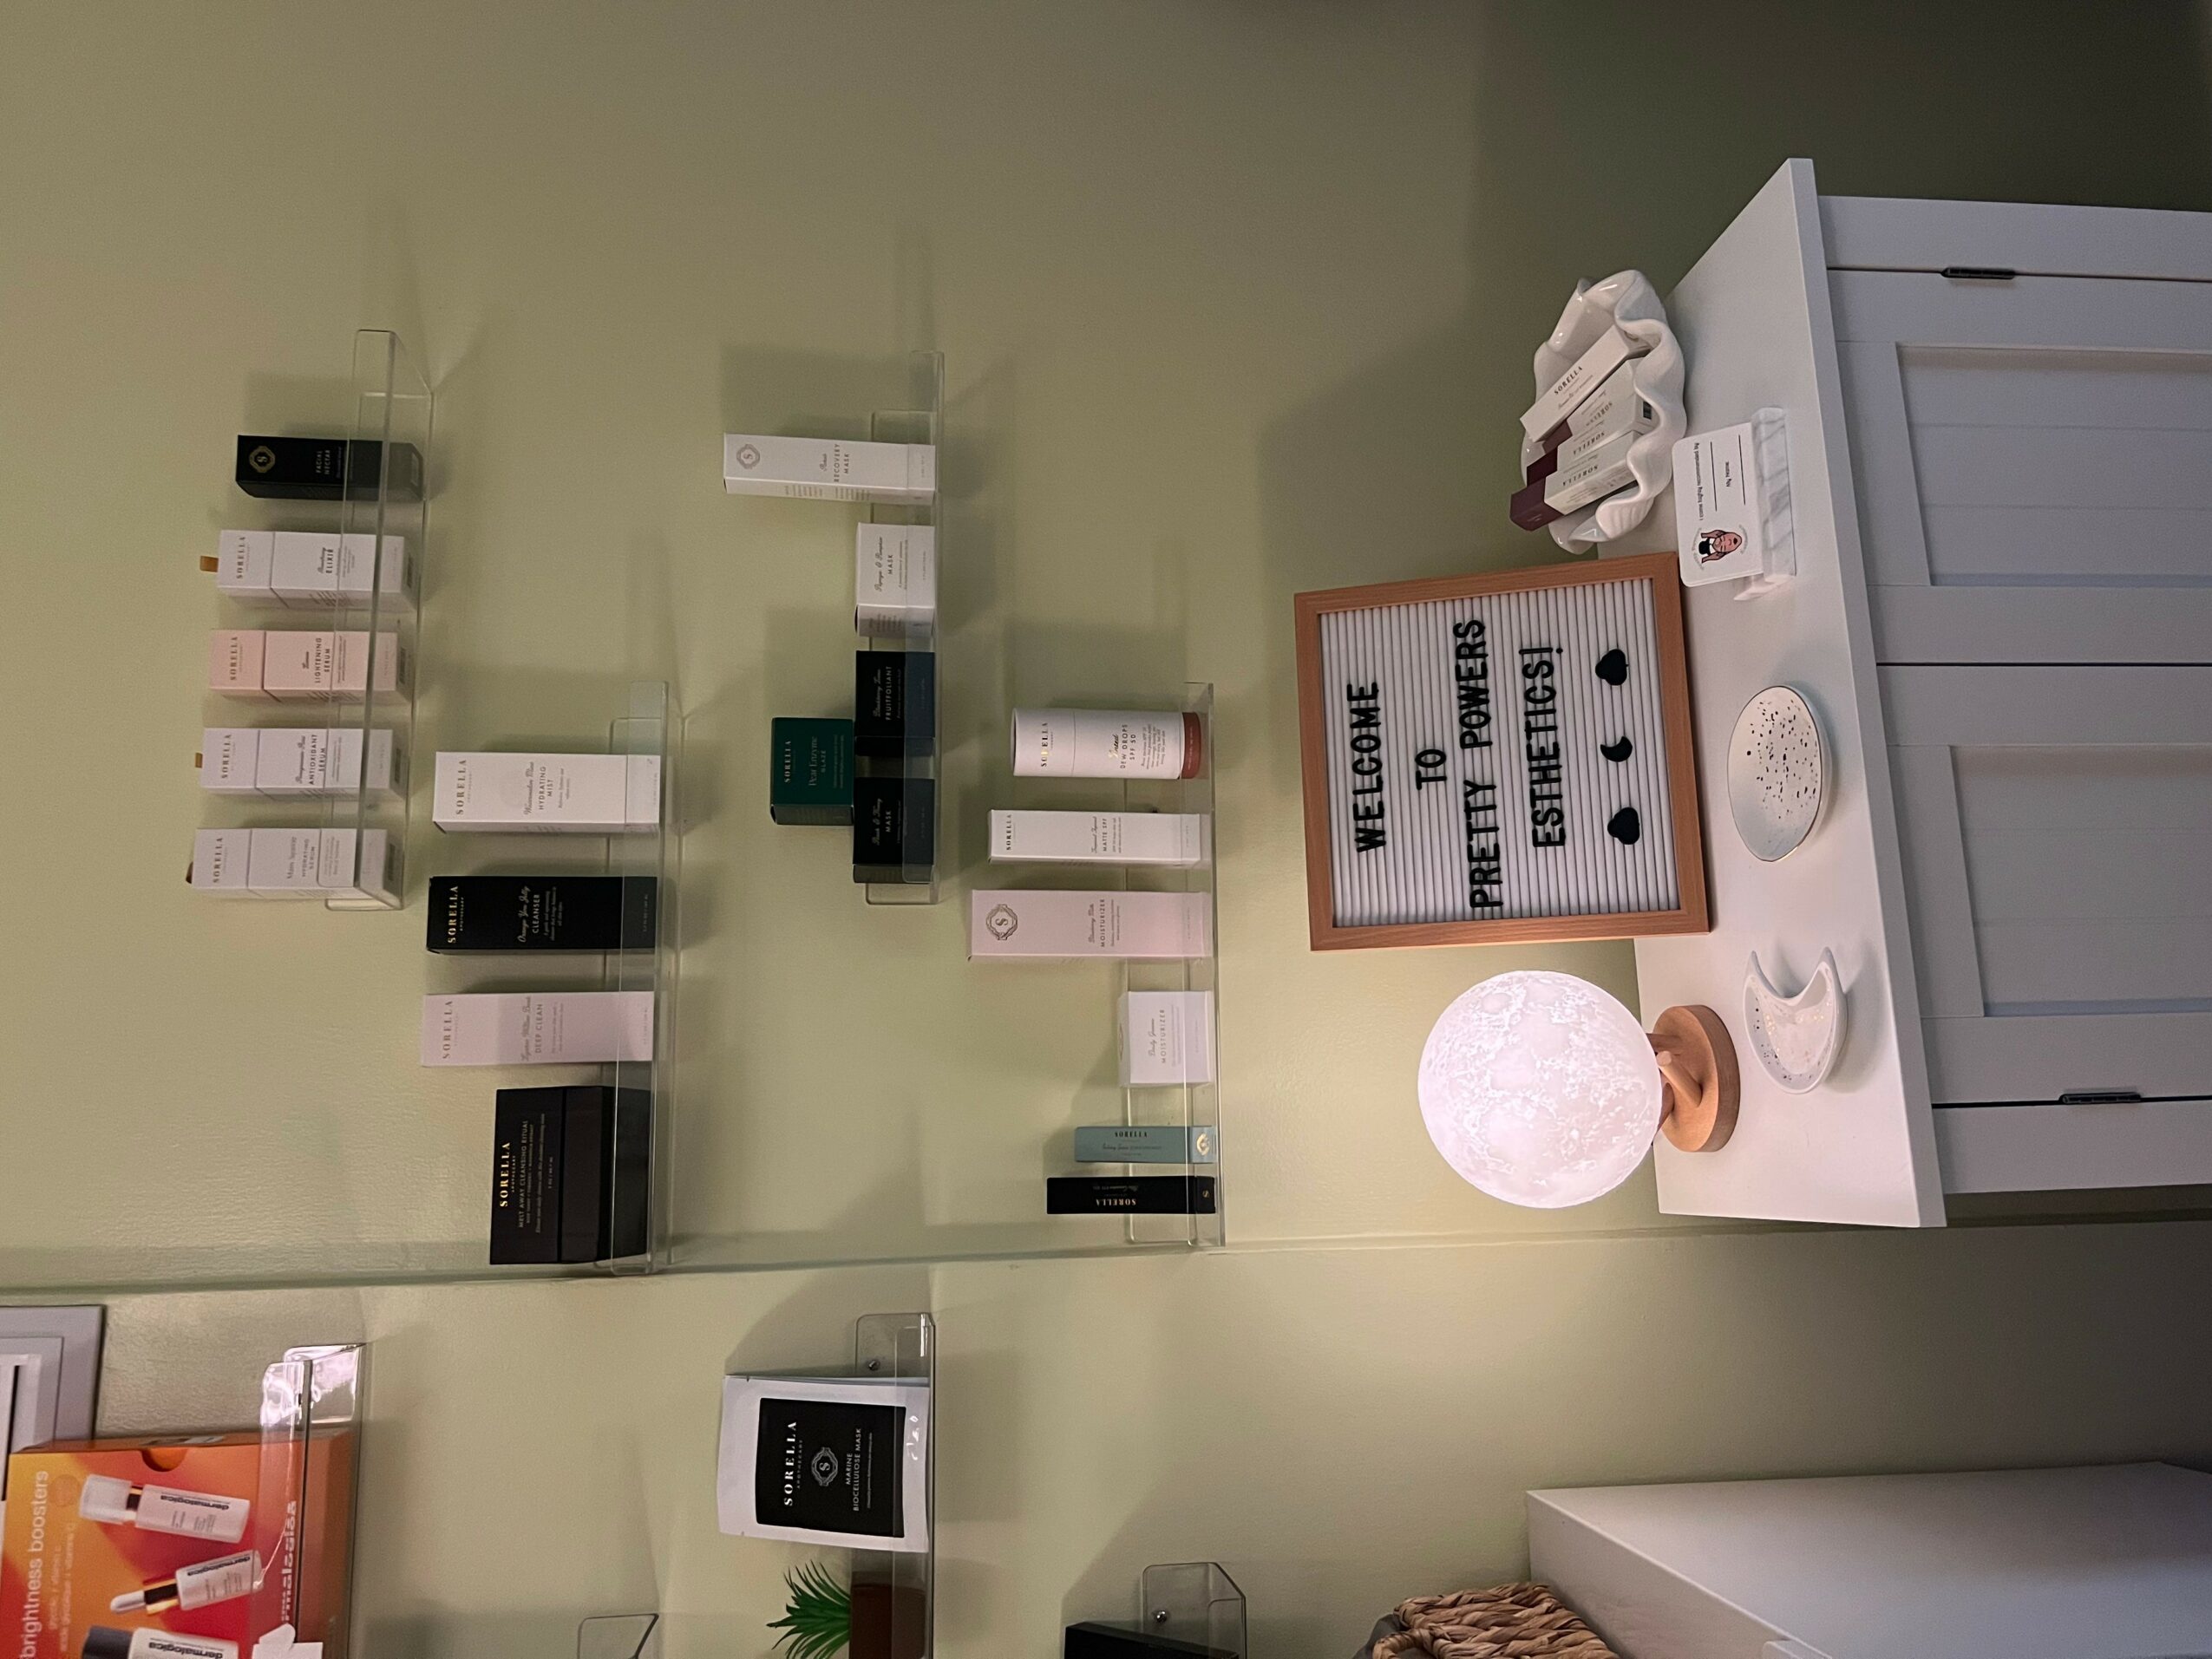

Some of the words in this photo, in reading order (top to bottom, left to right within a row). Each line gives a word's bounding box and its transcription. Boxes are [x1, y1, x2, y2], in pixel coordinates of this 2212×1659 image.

[1553, 364, 1584, 395] SORELLA
[833, 442, 841, 482] RECOVERY
[1573, 431, 1606, 456] SORELLA
[1562, 464, 1599, 486] SORELLA
[1693, 450, 1702, 486] recommended
[1725, 478, 1732, 487] My
[236, 536, 246, 579] SORELLA
[326, 548, 335, 574] ELIXIR
[229, 636, 239, 681] SORELLA
[314, 637, 323, 683] LIGHTENING
[323, 648, 331, 673] SERUM
[1452, 619, 1493, 749] POWERS
[220, 734, 232, 779] SORELLA
[808, 735, 821, 767] Enzyme
[1130, 734, 1136, 744] 50
[1518, 647, 1567, 848] ESTHETICS!
[309, 734, 318, 786] ANTIOXIDANT
[317, 747, 327, 772] SERUM
[808, 768, 818, 786] Pear
[1346, 682, 1386, 853] WELCOME
[1414, 748, 1447, 791] TO
[455, 759, 467, 815] SORELLA
[538, 766, 546, 810] HYDRATING
[212, 837, 224, 883] SORELLA
[1463, 779, 1504, 909] PRETTY
[518, 904, 530, 918] You
[519, 885, 531, 903] Jelly
[532, 893, 540, 933] CLEANSER
[448, 885, 459, 944] SORELLA
[517, 918, 529, 942] Orange
[442, 1000, 453, 1059] SORELLA
[534, 1003, 543, 1030] CLEAN
[499, 1141, 511, 1207] SORELLA
[783, 1421, 797, 1506] SORELLA
[845, 1453, 854, 1485] MARINE
[853, 1453, 861, 1511] BIOCELLULOSE
[27, 1470, 49, 1552] boosters
[160, 1494, 230, 1511] dermalogica
[187, 1555, 252, 1577] dermalogica
[19, 1558, 44, 1659] brightness
[147, 1642, 224, 1659] dermalogica
